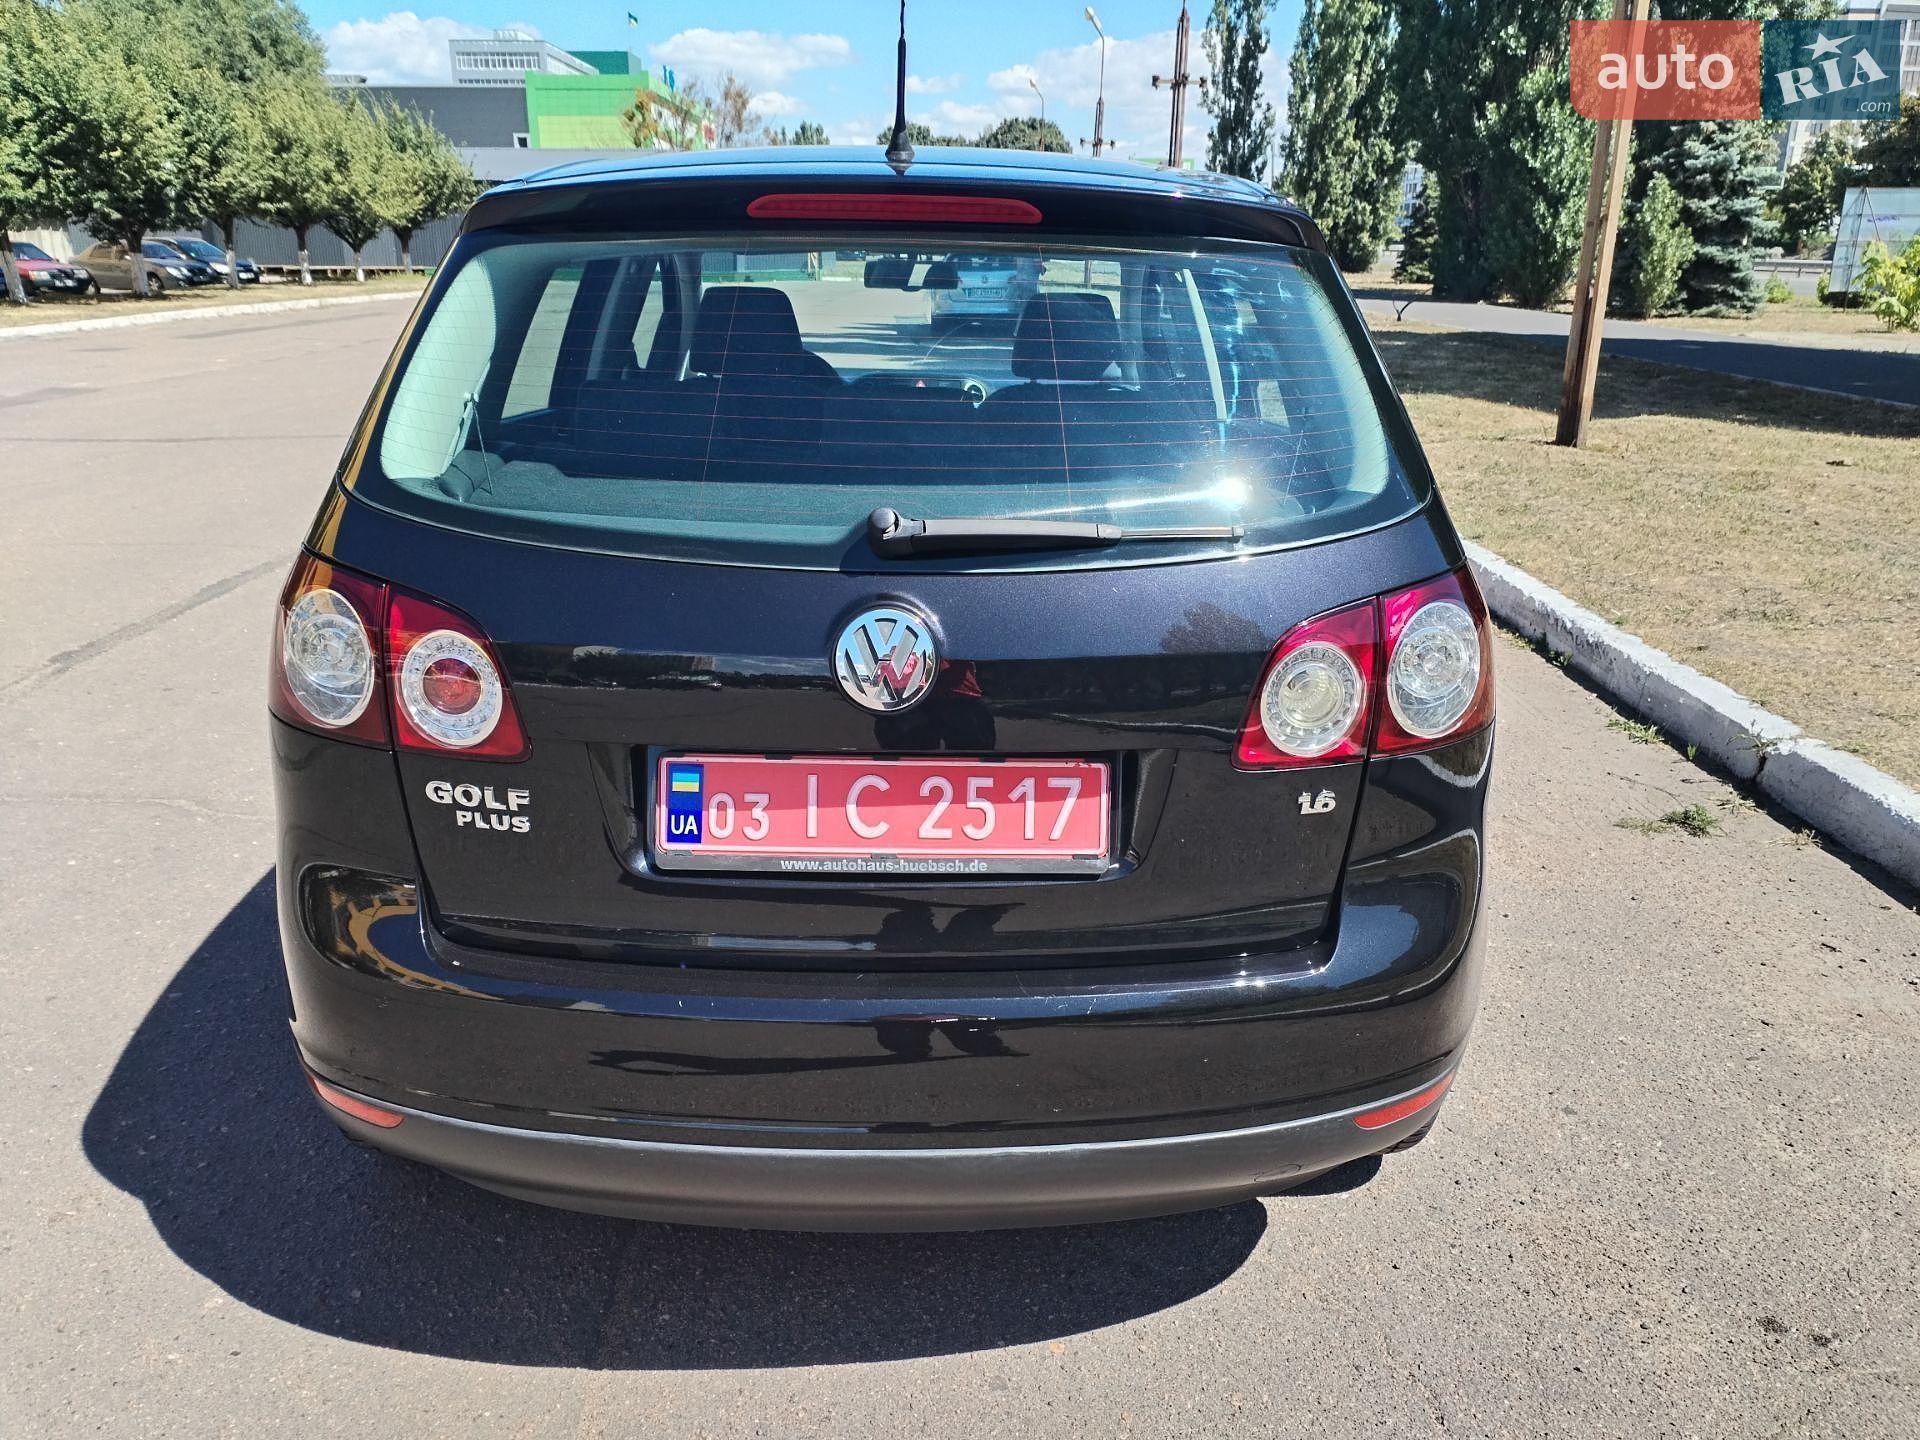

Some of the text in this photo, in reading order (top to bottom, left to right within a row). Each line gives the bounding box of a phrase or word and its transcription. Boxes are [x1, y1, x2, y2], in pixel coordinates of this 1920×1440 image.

[425, 780, 531, 811] GOLF
[708, 792, 770, 841] 03
[918, 776, 1082, 841] 2517
[455, 810, 531, 833] PLUS
[669, 814, 699, 835] UA
[780, 858, 989, 873] www.autohaus-huebsch.de
